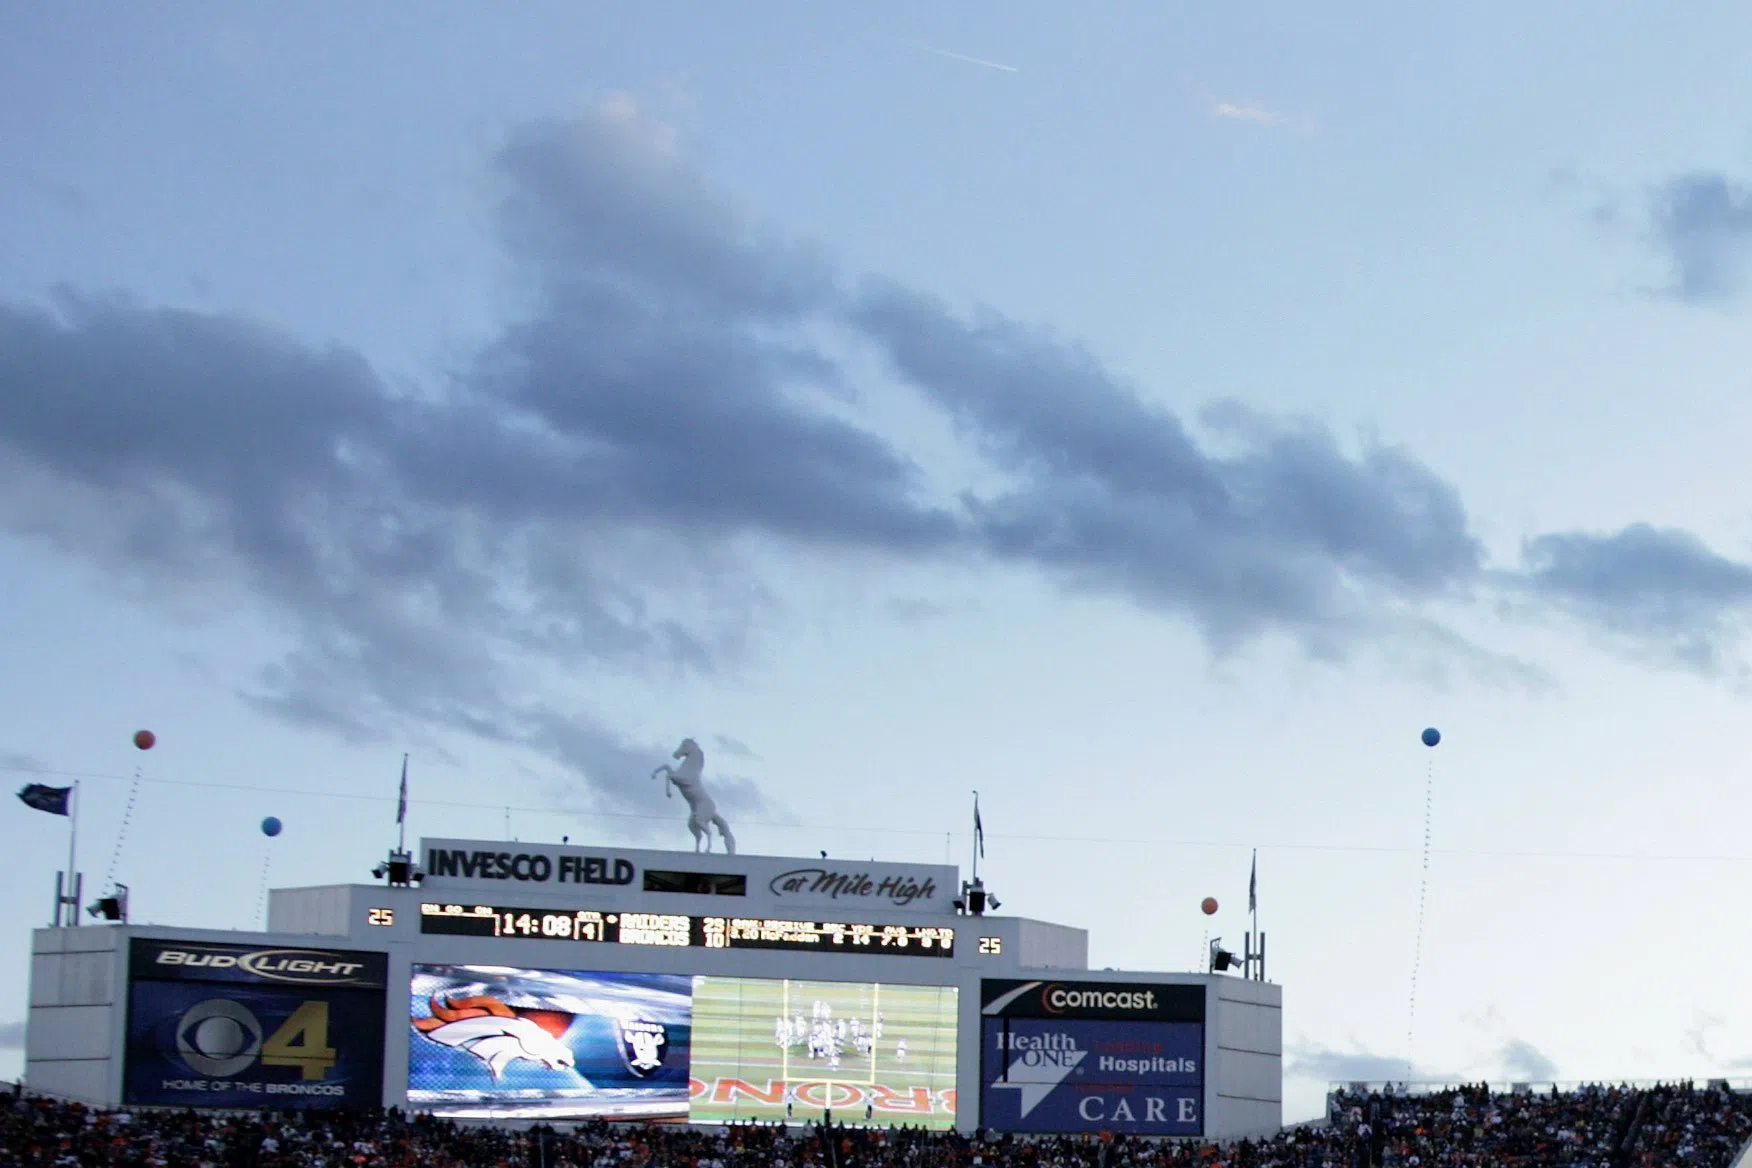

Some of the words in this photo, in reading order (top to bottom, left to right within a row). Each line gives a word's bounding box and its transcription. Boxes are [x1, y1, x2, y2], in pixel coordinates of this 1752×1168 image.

[428, 847, 549, 883] INVESCO
[558, 855, 635, 886] FIELD
[813, 870, 872, 897] Mile
[876, 874, 936, 905] High
[368, 908, 393, 926] 25
[503, 914, 571, 937] 14:08
[620, 913, 690, 931] RAIDERS
[582, 923, 595, 939] 4
[619, 929, 690, 946] BRONCOS
[704, 932, 725, 947] 10
[979, 937, 1000, 954] 25
[156, 950, 239, 968] BUD
[256, 956, 364, 975] LIGHT
[261, 1000, 338, 1081] 4
[996, 1032, 1077, 1051] Health
[1023, 1050, 1075, 1067] ONE
[1099, 1056, 1197, 1075] Hospitals
[162, 1079, 208, 1092] HOME
[211, 1081, 231, 1092] OF
[235, 1082, 261, 1094] THE
[266, 1083, 345, 1096] BRONCOS
[1078, 1096, 1198, 1123] CARE
